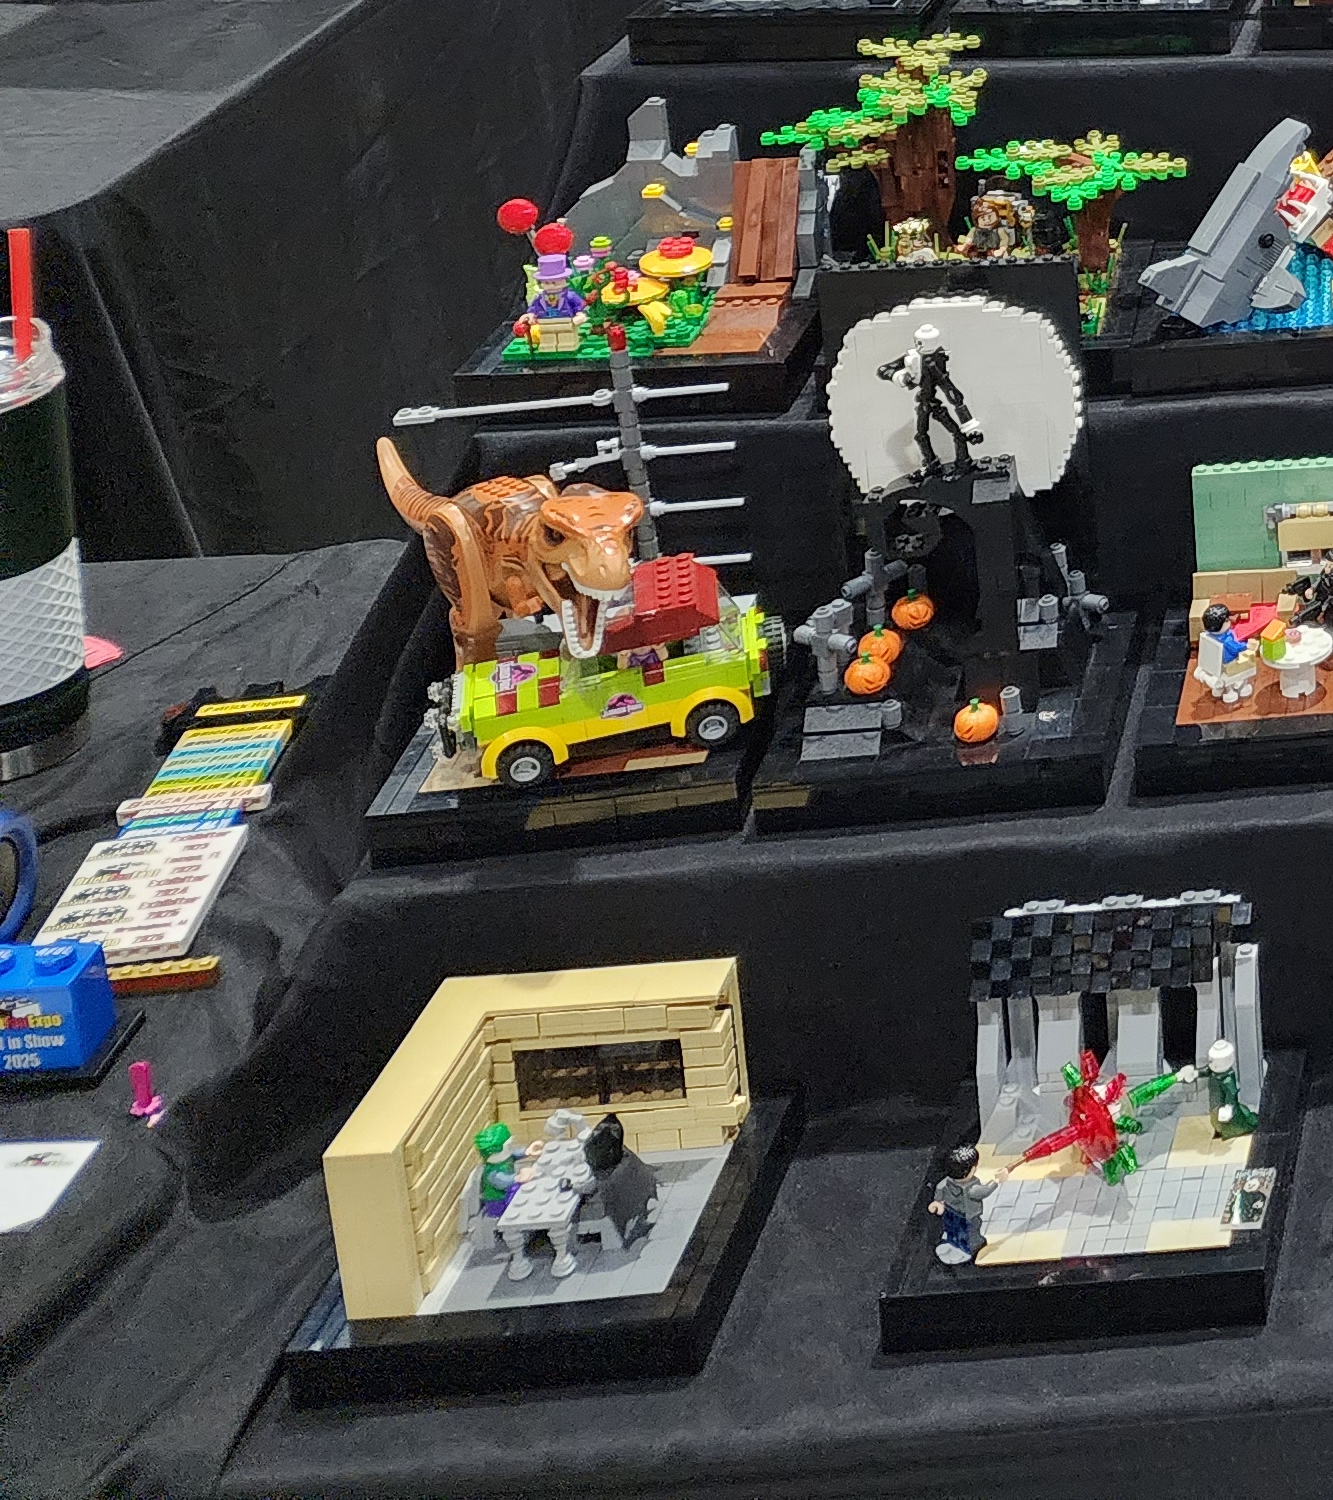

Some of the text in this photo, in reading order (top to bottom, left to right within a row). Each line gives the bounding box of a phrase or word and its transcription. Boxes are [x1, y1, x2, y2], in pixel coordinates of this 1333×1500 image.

[203, 703, 247, 713] Patrick
[24, 1033, 66, 1049] Show
[3, 1052, 41, 1070] 2025
